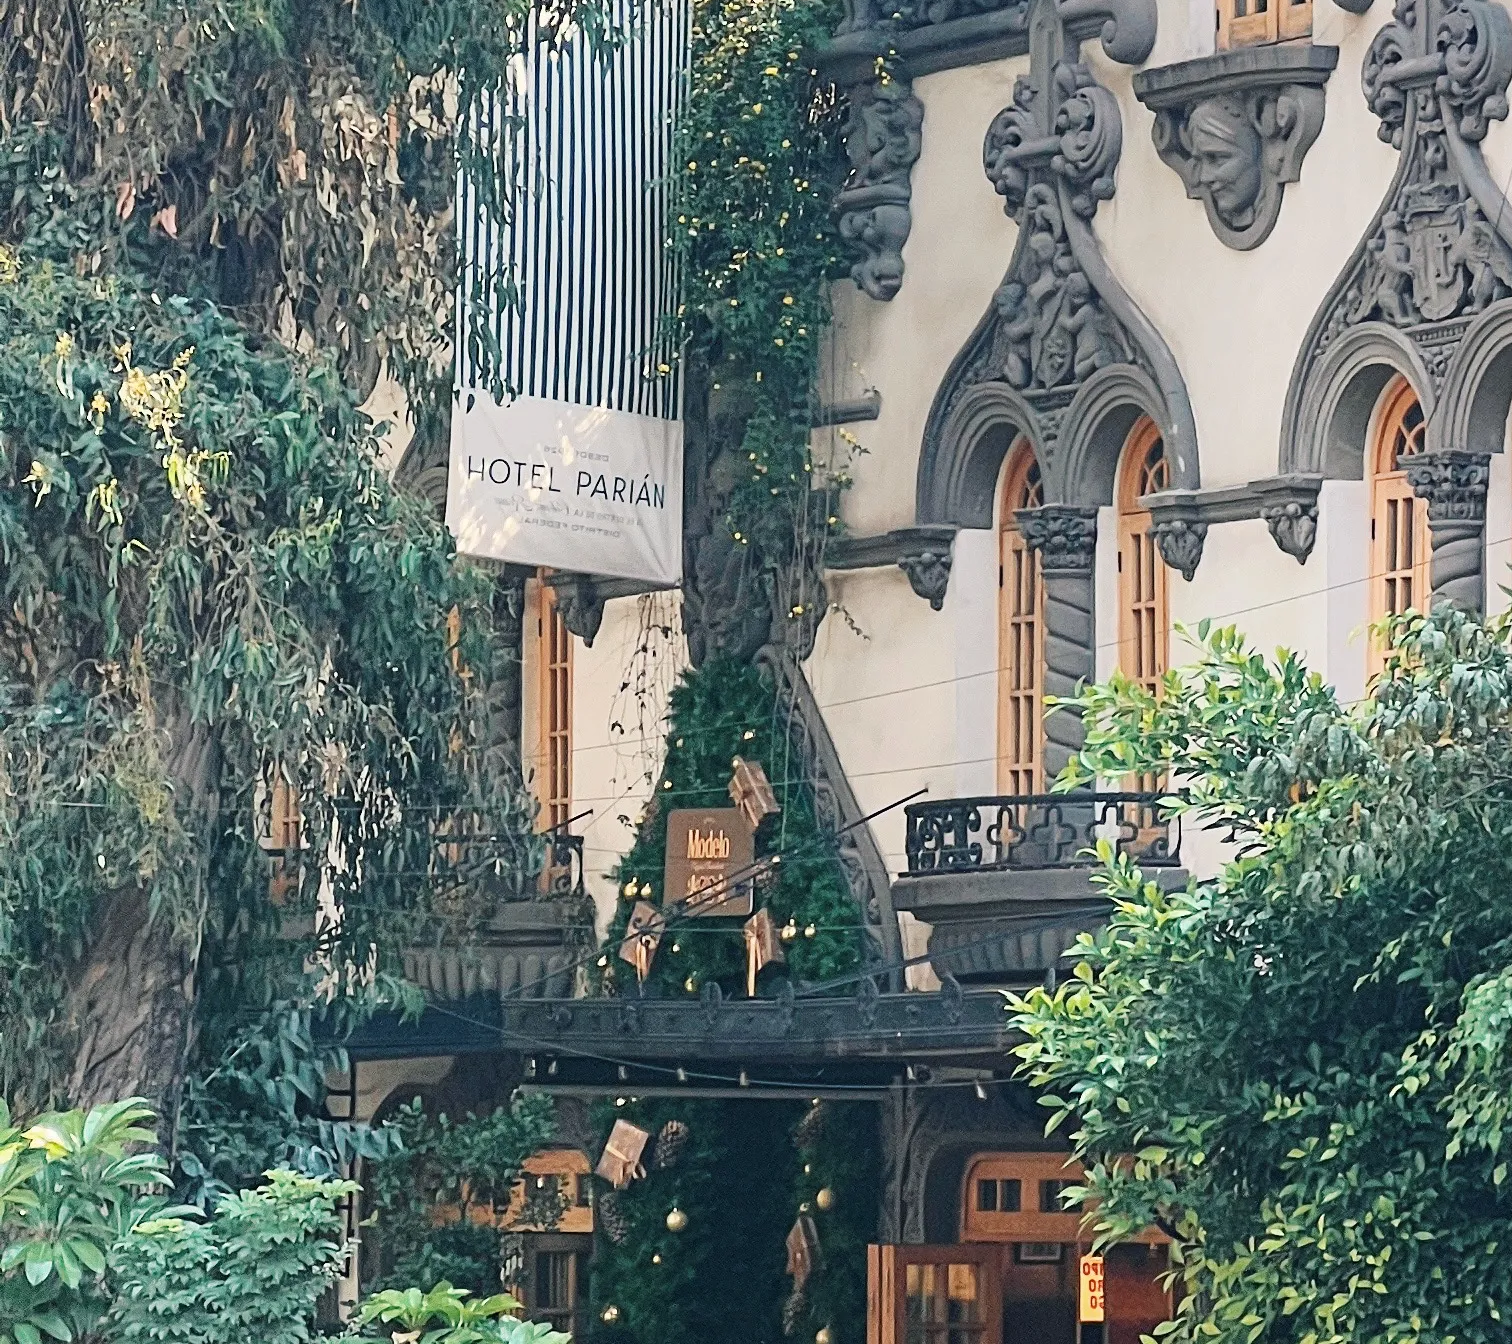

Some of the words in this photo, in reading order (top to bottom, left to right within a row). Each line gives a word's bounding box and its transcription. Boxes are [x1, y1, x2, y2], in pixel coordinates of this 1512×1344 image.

[467, 455, 561, 493] HOTEL
[576, 470, 665, 510] PARIÁN
[687, 829, 730, 858] Modelo
